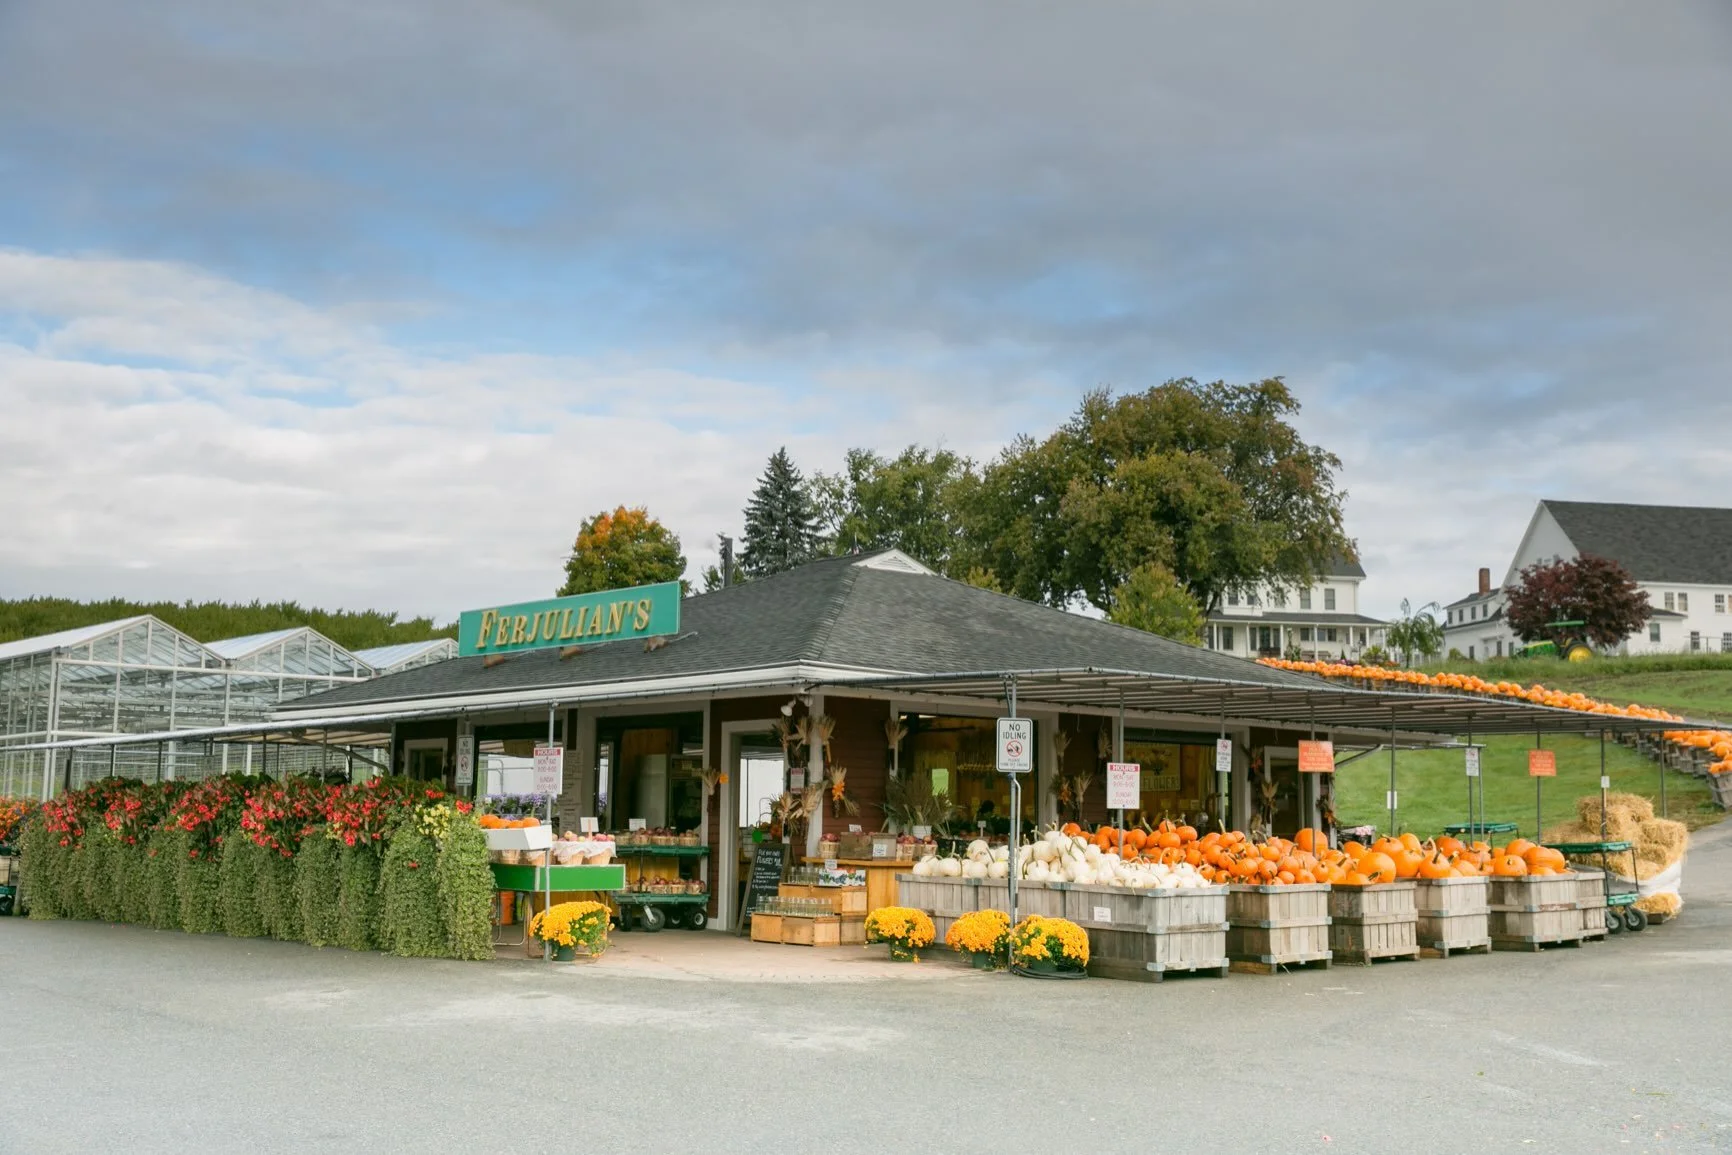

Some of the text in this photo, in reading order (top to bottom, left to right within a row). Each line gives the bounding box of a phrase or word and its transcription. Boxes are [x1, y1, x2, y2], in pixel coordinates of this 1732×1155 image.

[475, 599, 653, 649] FERJULIAN'S
[1009, 723, 1021, 731] NO
[1003, 732, 1027, 740] IDLING
